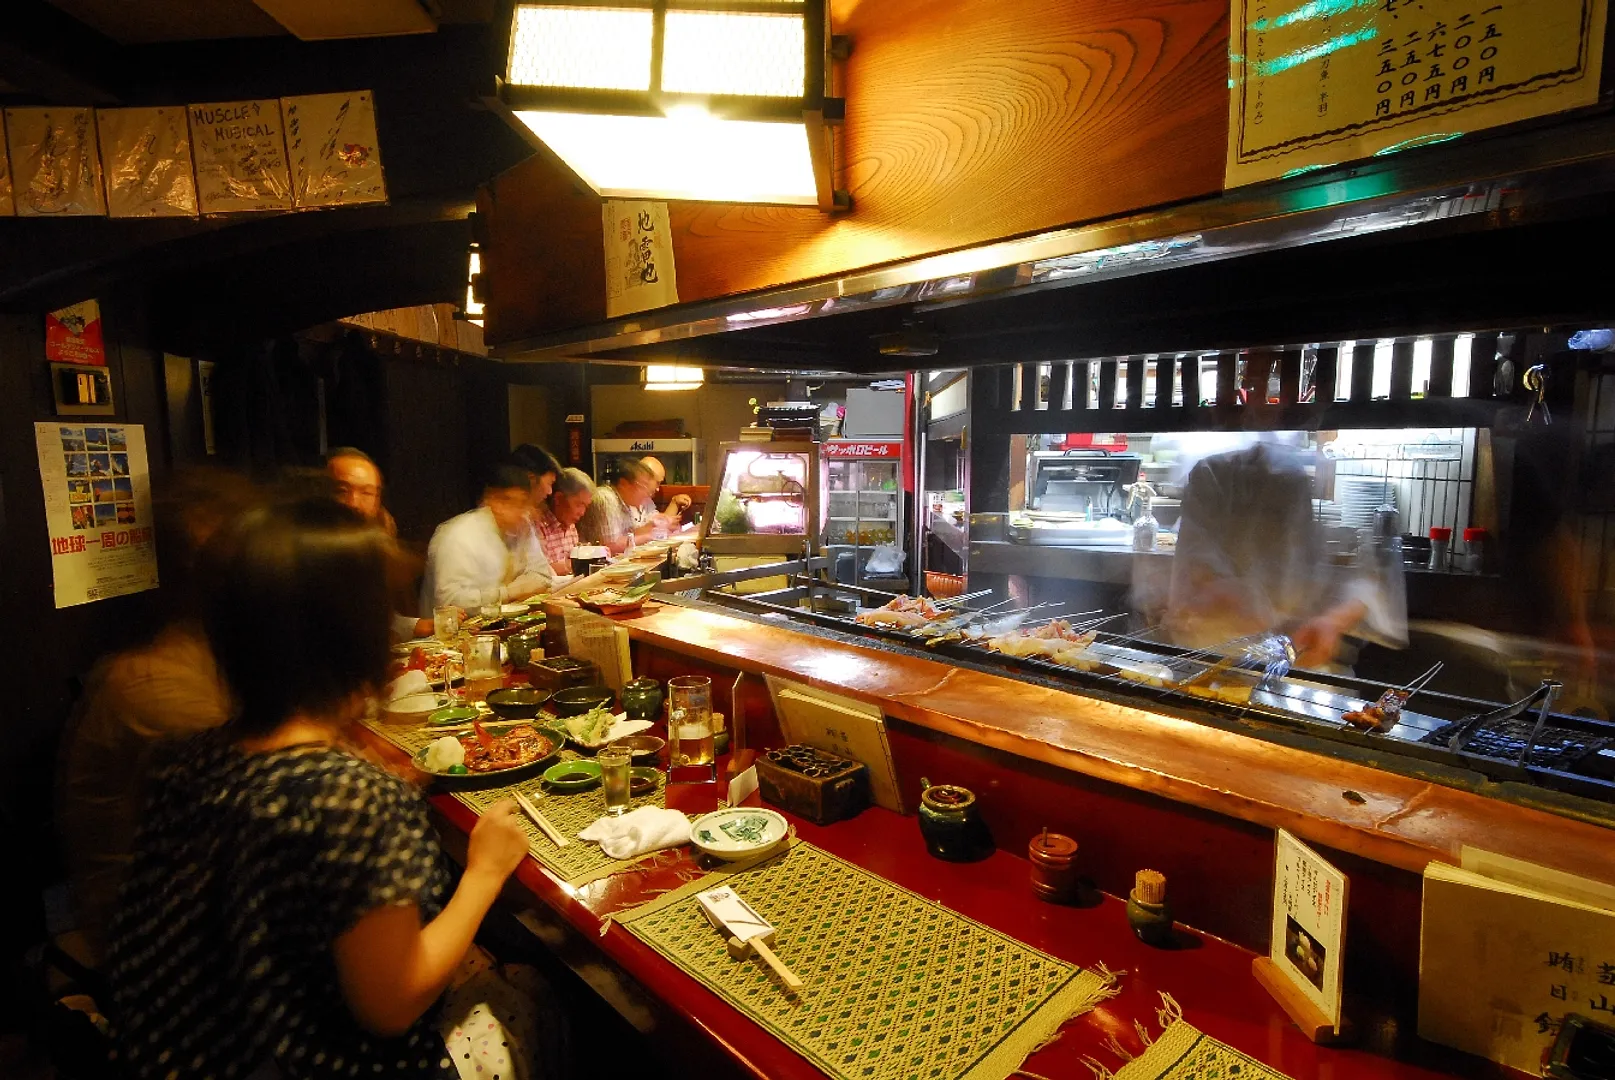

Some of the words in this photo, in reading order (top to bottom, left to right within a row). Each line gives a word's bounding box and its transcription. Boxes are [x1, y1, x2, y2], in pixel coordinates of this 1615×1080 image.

[1423, 21, 1447, 101] 六七五円
[193, 104, 250, 127] MUSCLE
[215, 123, 275, 142] MUSICAL
[629, 440, 654, 452] Asahi
